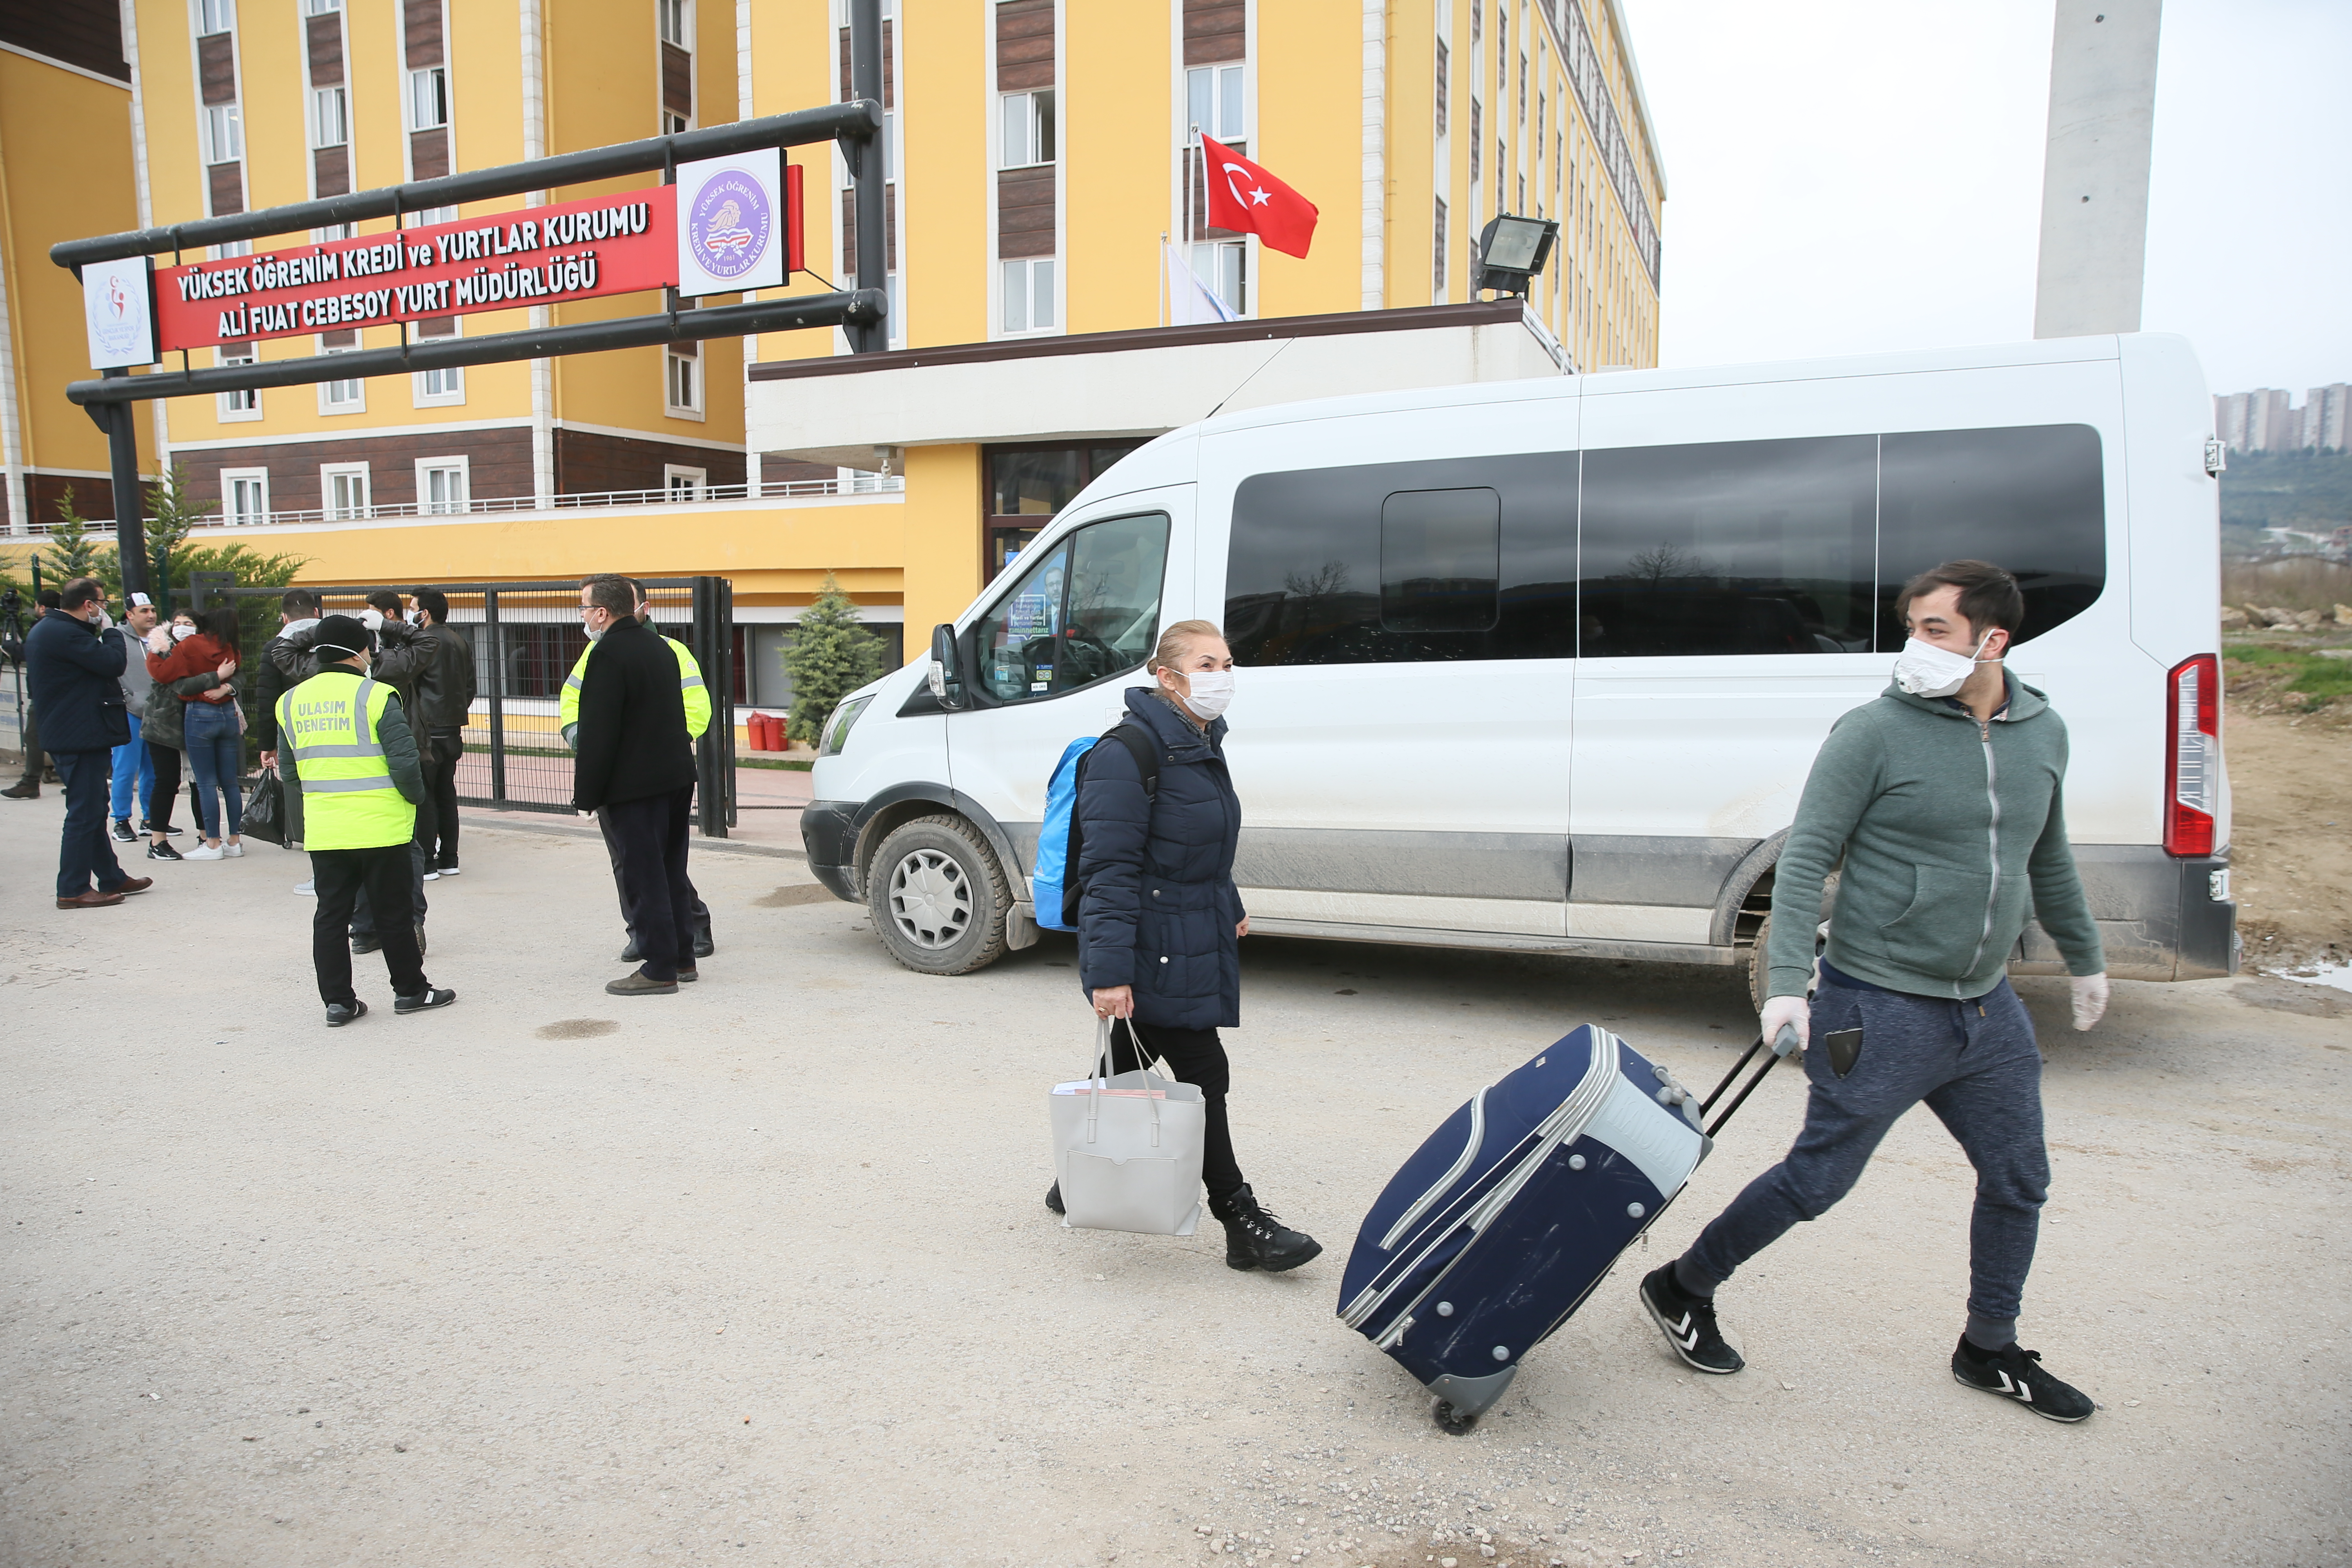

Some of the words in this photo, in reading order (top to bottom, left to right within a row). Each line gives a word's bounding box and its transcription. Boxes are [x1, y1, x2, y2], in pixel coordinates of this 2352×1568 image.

[699, 184, 725, 218] YÜKSEK
[727, 181, 760, 211] ÖĞRENİM
[177, 266, 250, 302] YÜKSEK
[252, 247, 338, 292] ÖĞRENİM
[342, 234, 403, 278] KREDİ
[408, 244, 432, 267] ve
[436, 221, 538, 263] YURTLAR
[544, 203, 647, 247] KURUMU
[701, 252, 710, 268] VE
[711, 258, 750, 275] YURTLAR
[750, 212, 768, 262] KURUMU
[218, 302, 246, 338] ALİ
[250, 301, 298, 334] FUAT
[302, 289, 390, 326] CEBESOY
[395, 280, 450, 314] YURT
[456, 251, 596, 306] MÜDÜRLÜĞÜ
[295, 715, 350, 734] DENETİM
[299, 701, 345, 716] ULASIM
[1607, 1096, 1687, 1171] KAISER
